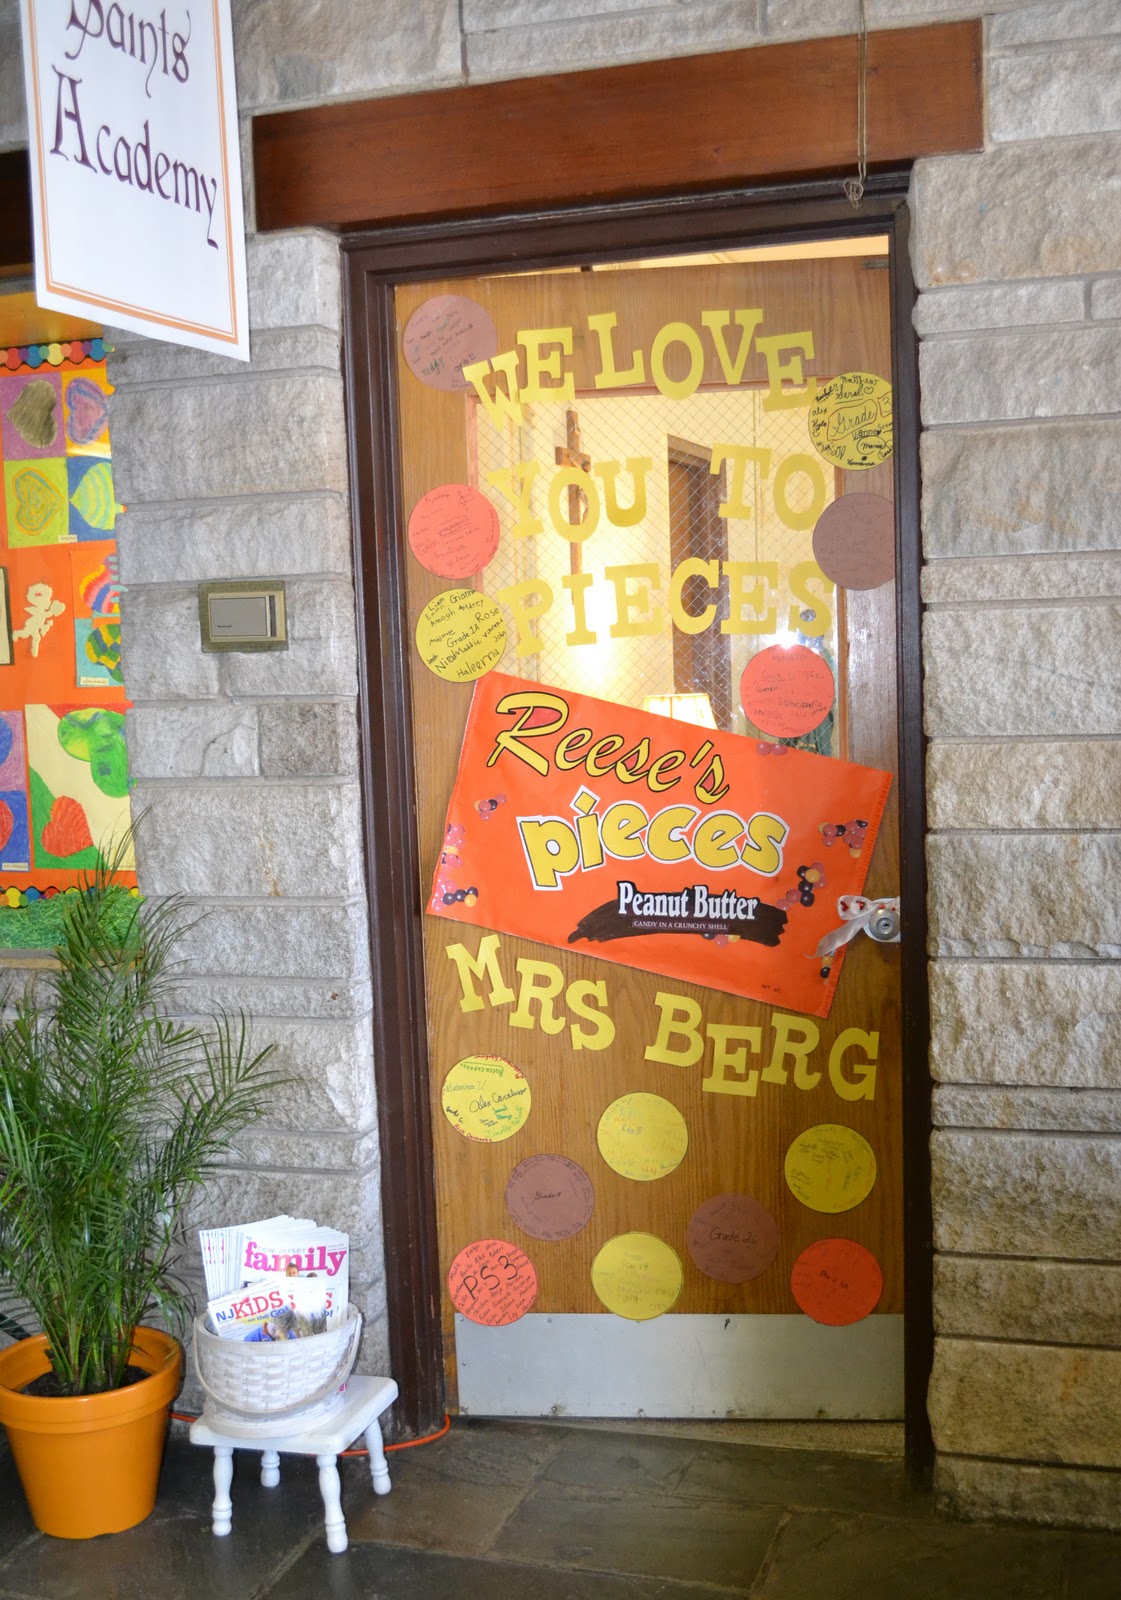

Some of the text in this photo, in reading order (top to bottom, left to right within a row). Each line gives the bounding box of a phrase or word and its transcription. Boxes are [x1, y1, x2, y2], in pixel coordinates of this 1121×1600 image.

[50, 64, 219, 250] Academy
[463, 327, 575, 432] WE
[588, 309, 817, 412] LOVE
[488, 456, 652, 543] YOU
[710, 443, 826, 531] TO
[446, 631, 470, 648] Grade
[475, 607, 500, 623] Rose
[500, 557, 835, 657] PIECES
[486, 691, 730, 805] Reese's
[516, 785, 790, 891] pieces
[618, 882, 758, 920] Peanut Butter
[446, 934, 880, 1101] MRS BERG
[244, 1241, 347, 1276] family
[709, 1226, 740, 1242] Grade
[215, 1308, 235, 1322] NJ
